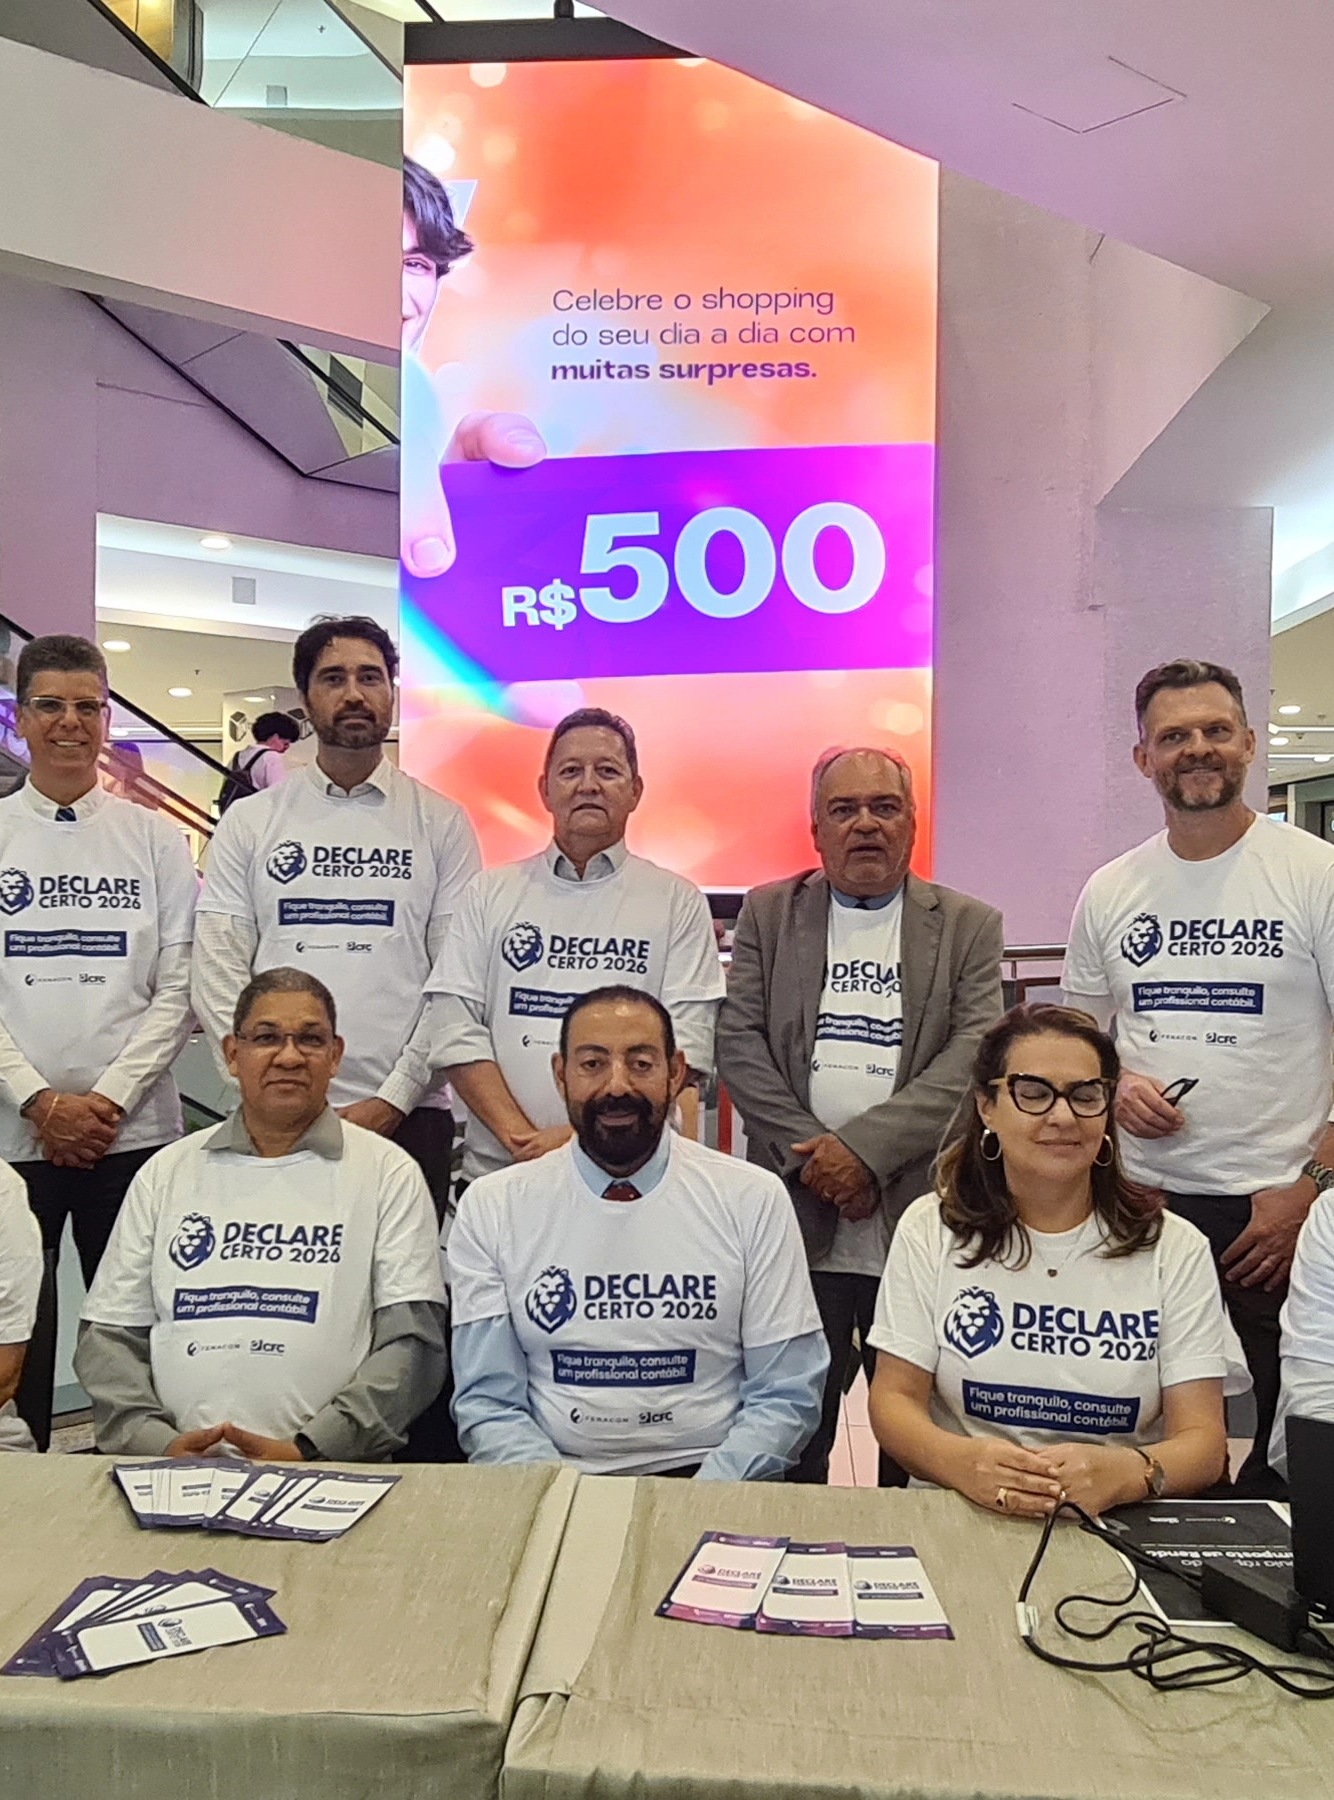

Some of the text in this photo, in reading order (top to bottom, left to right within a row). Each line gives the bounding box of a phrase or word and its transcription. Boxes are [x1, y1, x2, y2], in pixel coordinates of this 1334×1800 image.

[552, 286, 834, 315] Celebre o shopping
[552, 321, 855, 345] do seu dia a dia com
[551, 359, 817, 385] muitas surpresas.
[313, 846, 413, 867] DECLARE
[312, 864, 412, 880] CERTO 2026
[39, 874, 140, 896] DECLARE
[39, 894, 142, 910] CERTO 2026
[1169, 918, 1284, 942] DECLARE
[549, 934, 650, 960] DECLARE
[1167, 940, 1284, 958] CERTO 2026
[547, 955, 648, 974] CERTO 2026
[831, 980, 883, 995] CERTO
[1217, 1035, 1238, 1044] CFC
[223, 1221, 344, 1247] DECLARE
[220, 1243, 341, 1264] CERTO 2026
[179, 1289, 311, 1304] Fique tranquilo, consulte
[584, 1273, 717, 1300] DECLARE
[177, 1301, 308, 1316] um profissional contábil.
[584, 1301, 718, 1320] CERTO 2026
[1012, 1301, 1159, 1340] DECLARE
[262, 1342, 286, 1353] CFC
[1011, 1332, 1156, 1361] CERTO 2026
[557, 1353, 688, 1370] Fique tranquilo, consulte
[558, 1366, 687, 1381] um profissional contábil.
[969, 1387, 1132, 1415] Fique tranquilo, consulte
[651, 1411, 673, 1423] CFC
[971, 1402, 1129, 1428] um profissional contábil.
